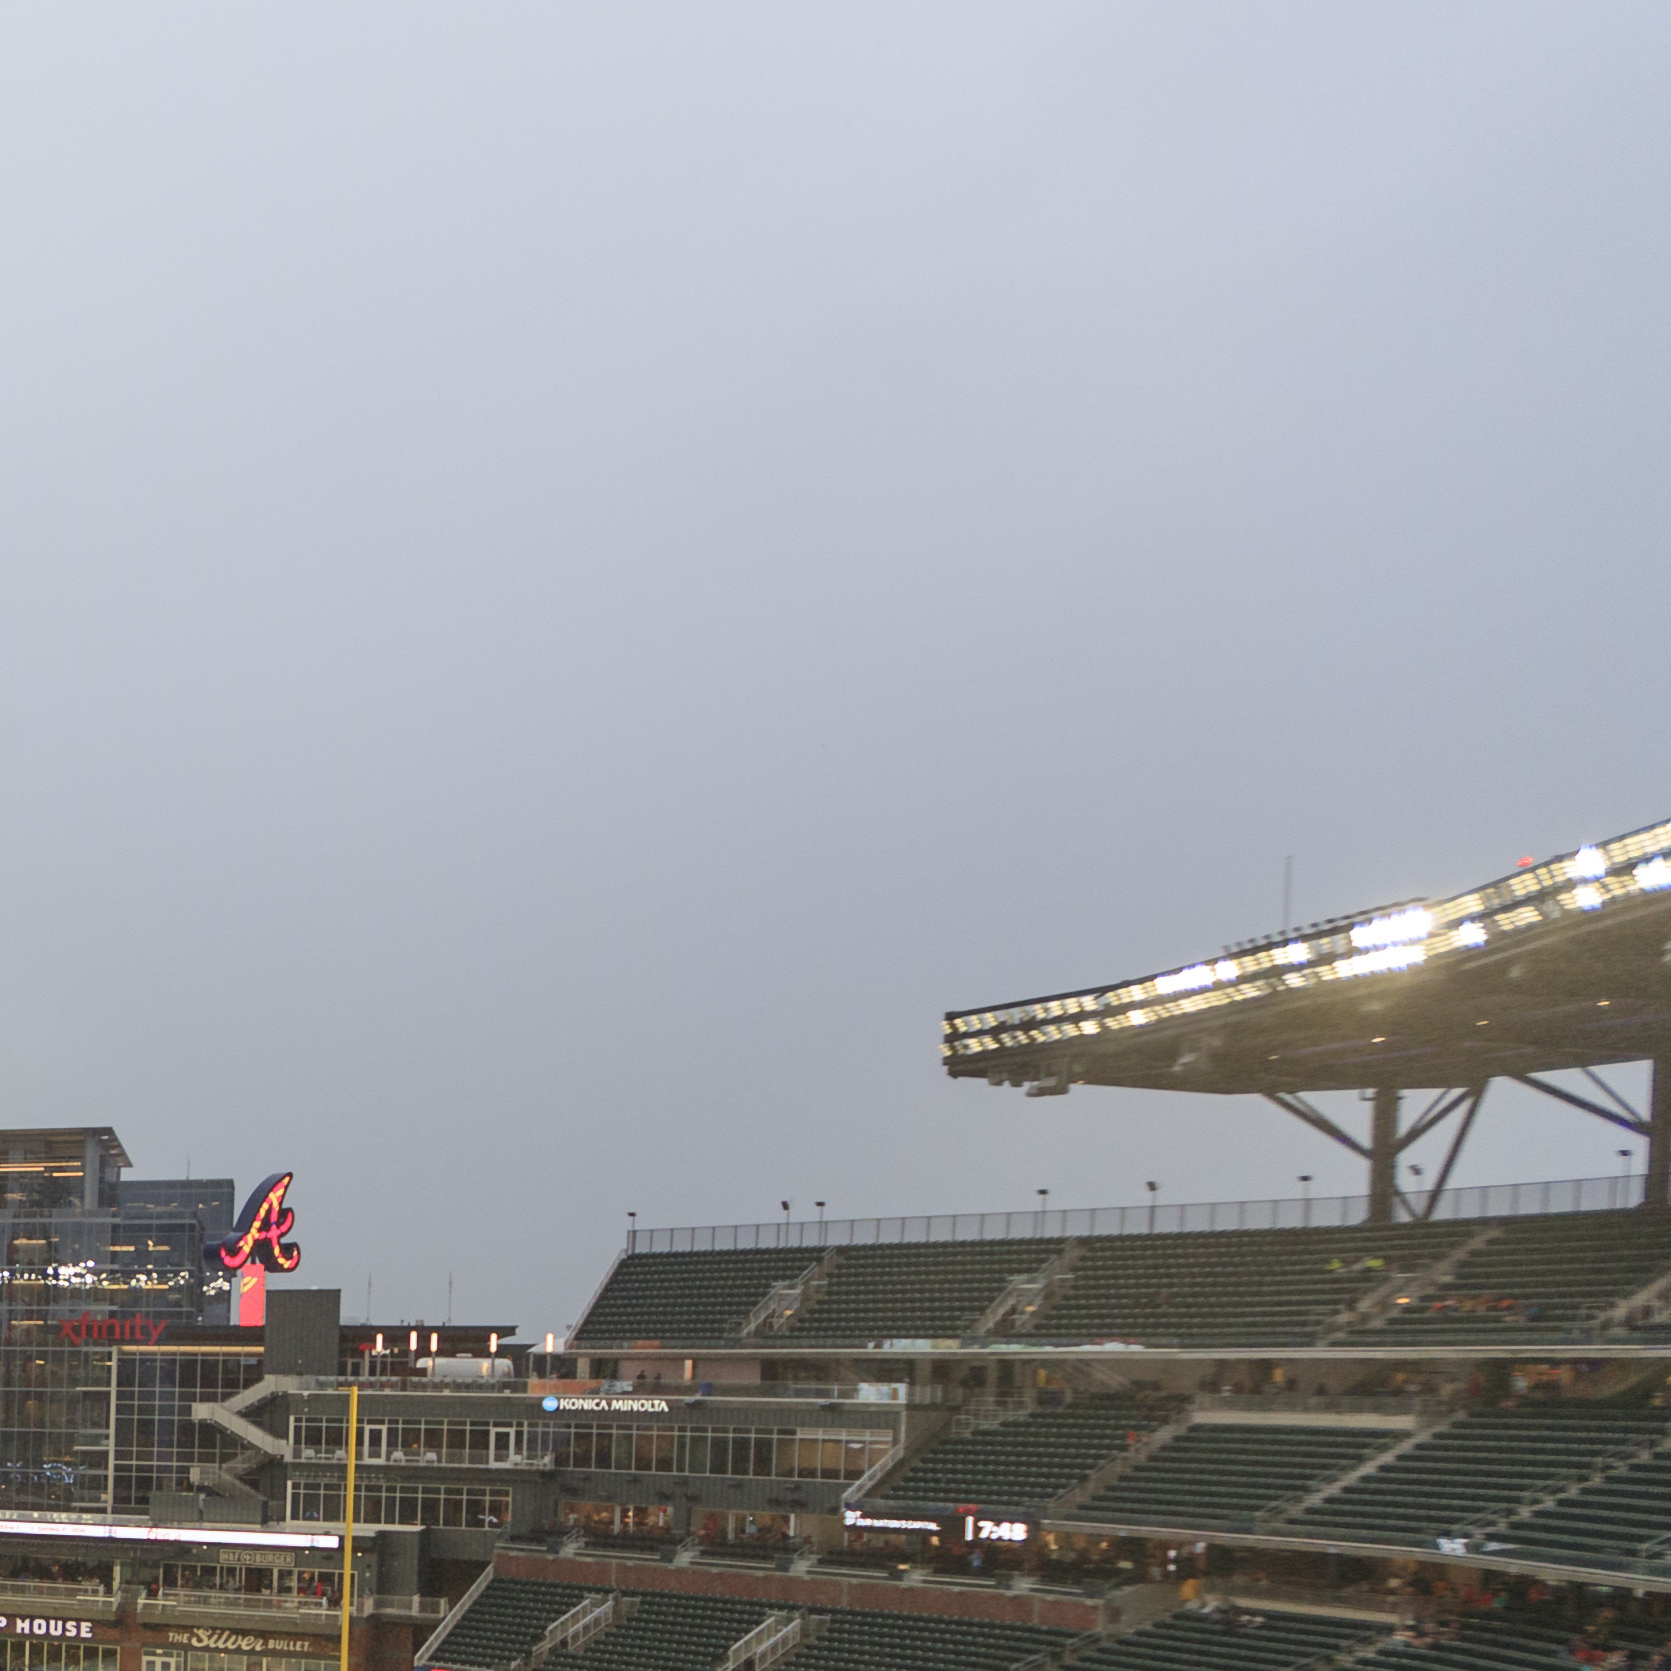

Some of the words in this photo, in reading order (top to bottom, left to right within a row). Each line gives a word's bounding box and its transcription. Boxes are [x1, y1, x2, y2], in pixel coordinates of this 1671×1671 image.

[58, 1311, 169, 1347] xfinity
[559, 1398, 609, 1411] KONICA
[610, 1399, 669, 1413] MINOLTA
[977, 1520, 1029, 1542] 7:48
[255, 1552, 294, 1565] BURGER
[168, 1632, 190, 1643] THE
[190, 1627, 266, 1651] Silver
[267, 1638, 310, 1652] BULLET
